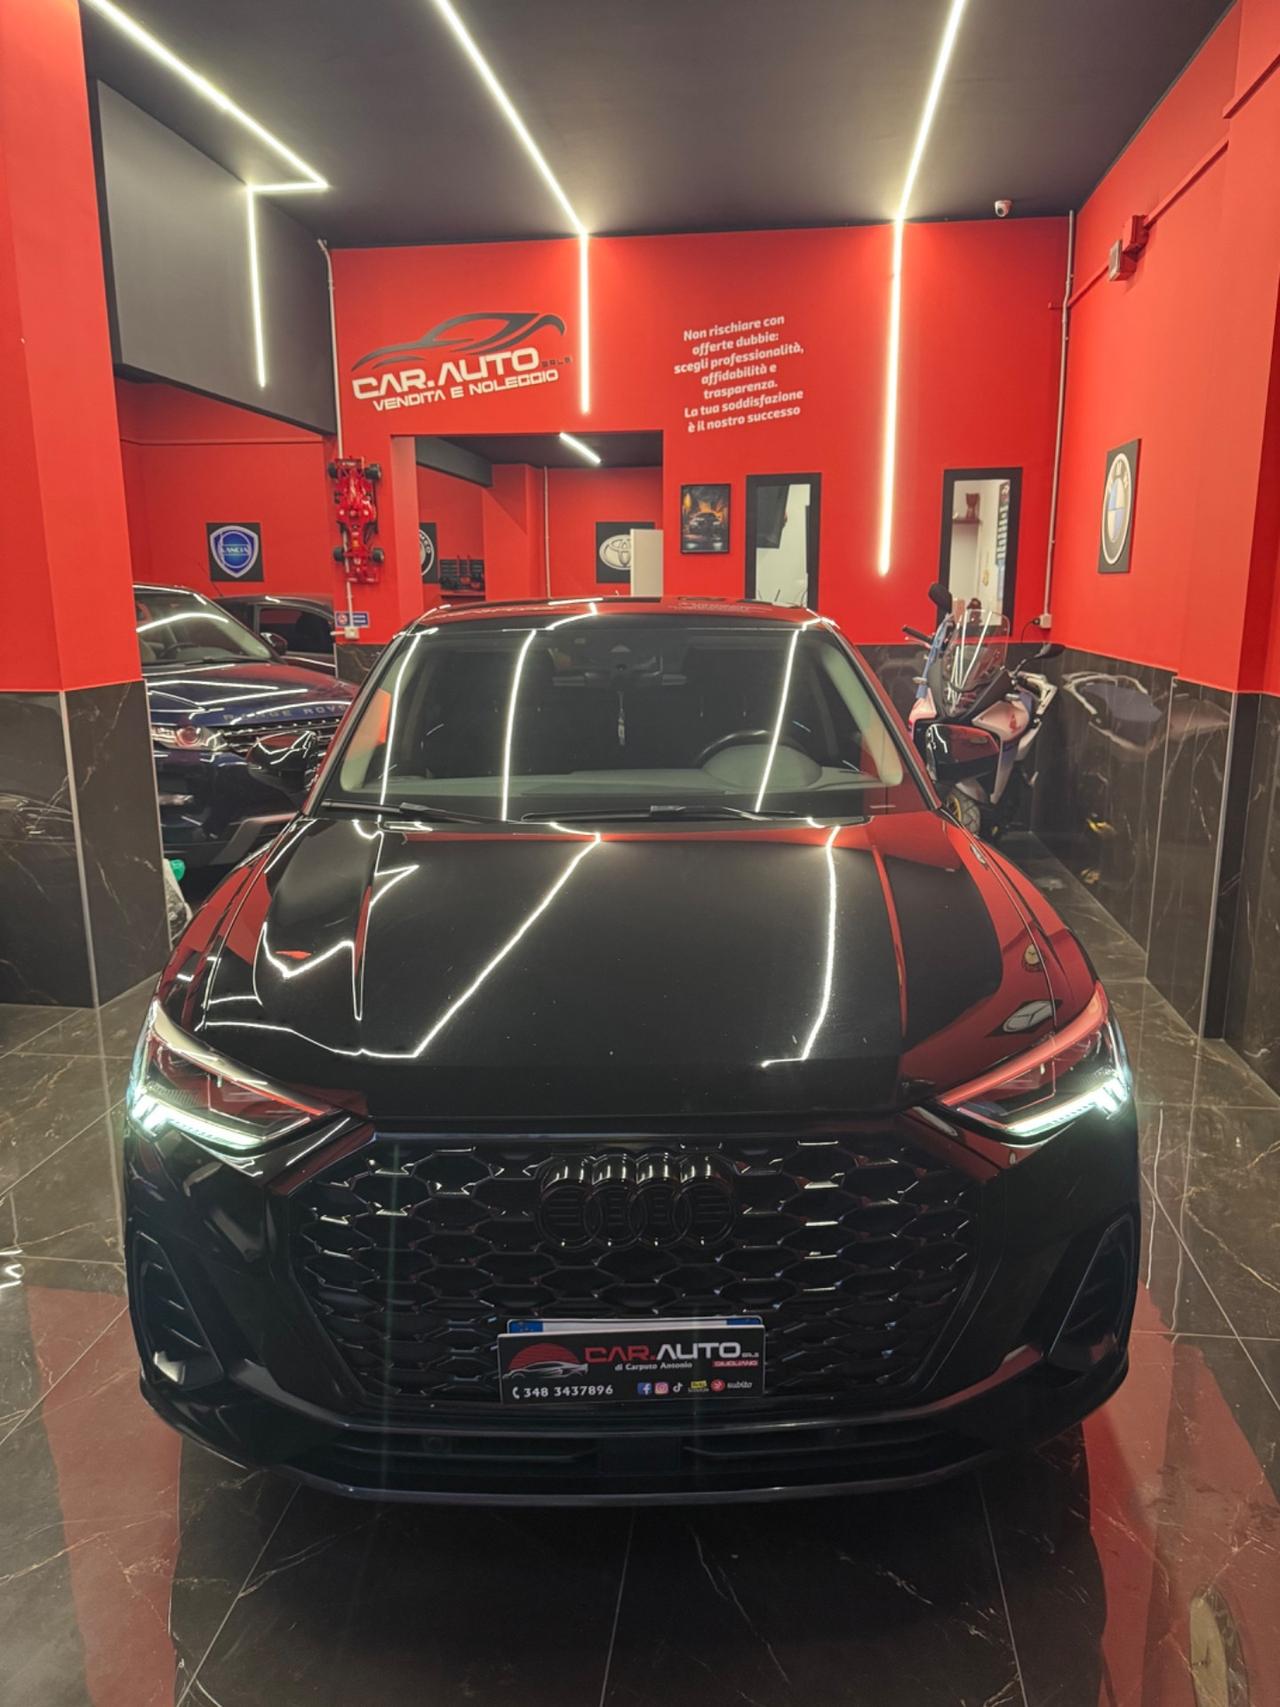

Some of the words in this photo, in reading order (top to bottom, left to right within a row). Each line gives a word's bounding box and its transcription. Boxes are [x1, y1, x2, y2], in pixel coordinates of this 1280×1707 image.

[683, 329, 707, 341] Non
[709, 320, 761, 336] rischiare
[763, 315, 785, 326] con
[692, 340, 734, 356] offerte
[736, 331, 779, 348] dubbie:
[674, 358, 708, 374] scegli
[710, 341, 804, 370] professionalità,
[352, 347, 540, 400] CAR.AUTO
[701, 363, 767, 386] affidabilità
[769, 364, 777, 373] e
[373, 390, 446, 411] VENDITA
[450, 386, 464, 399] E
[469, 368, 559, 395] NOLEGGIO
[703, 379, 778, 399] trasparenza.
[684, 407, 698, 418] La
[700, 404, 720, 416] tua
[722, 390, 803, 412] soddisfazione
[687, 422, 695, 433] è
[697, 420, 705, 432] il
[707, 415, 745, 430] nostro
[747, 406, 801, 423] successo
[585, 1342, 741, 1363] CAR.AUTO
[614, 1363, 623, 1371] di
[625, 1363, 658, 1372] Carputo
[660, 1361, 693, 1369] Antonio
[523, 1386, 549, 1398] 348
[553, 1384, 614, 1397] 3437896
